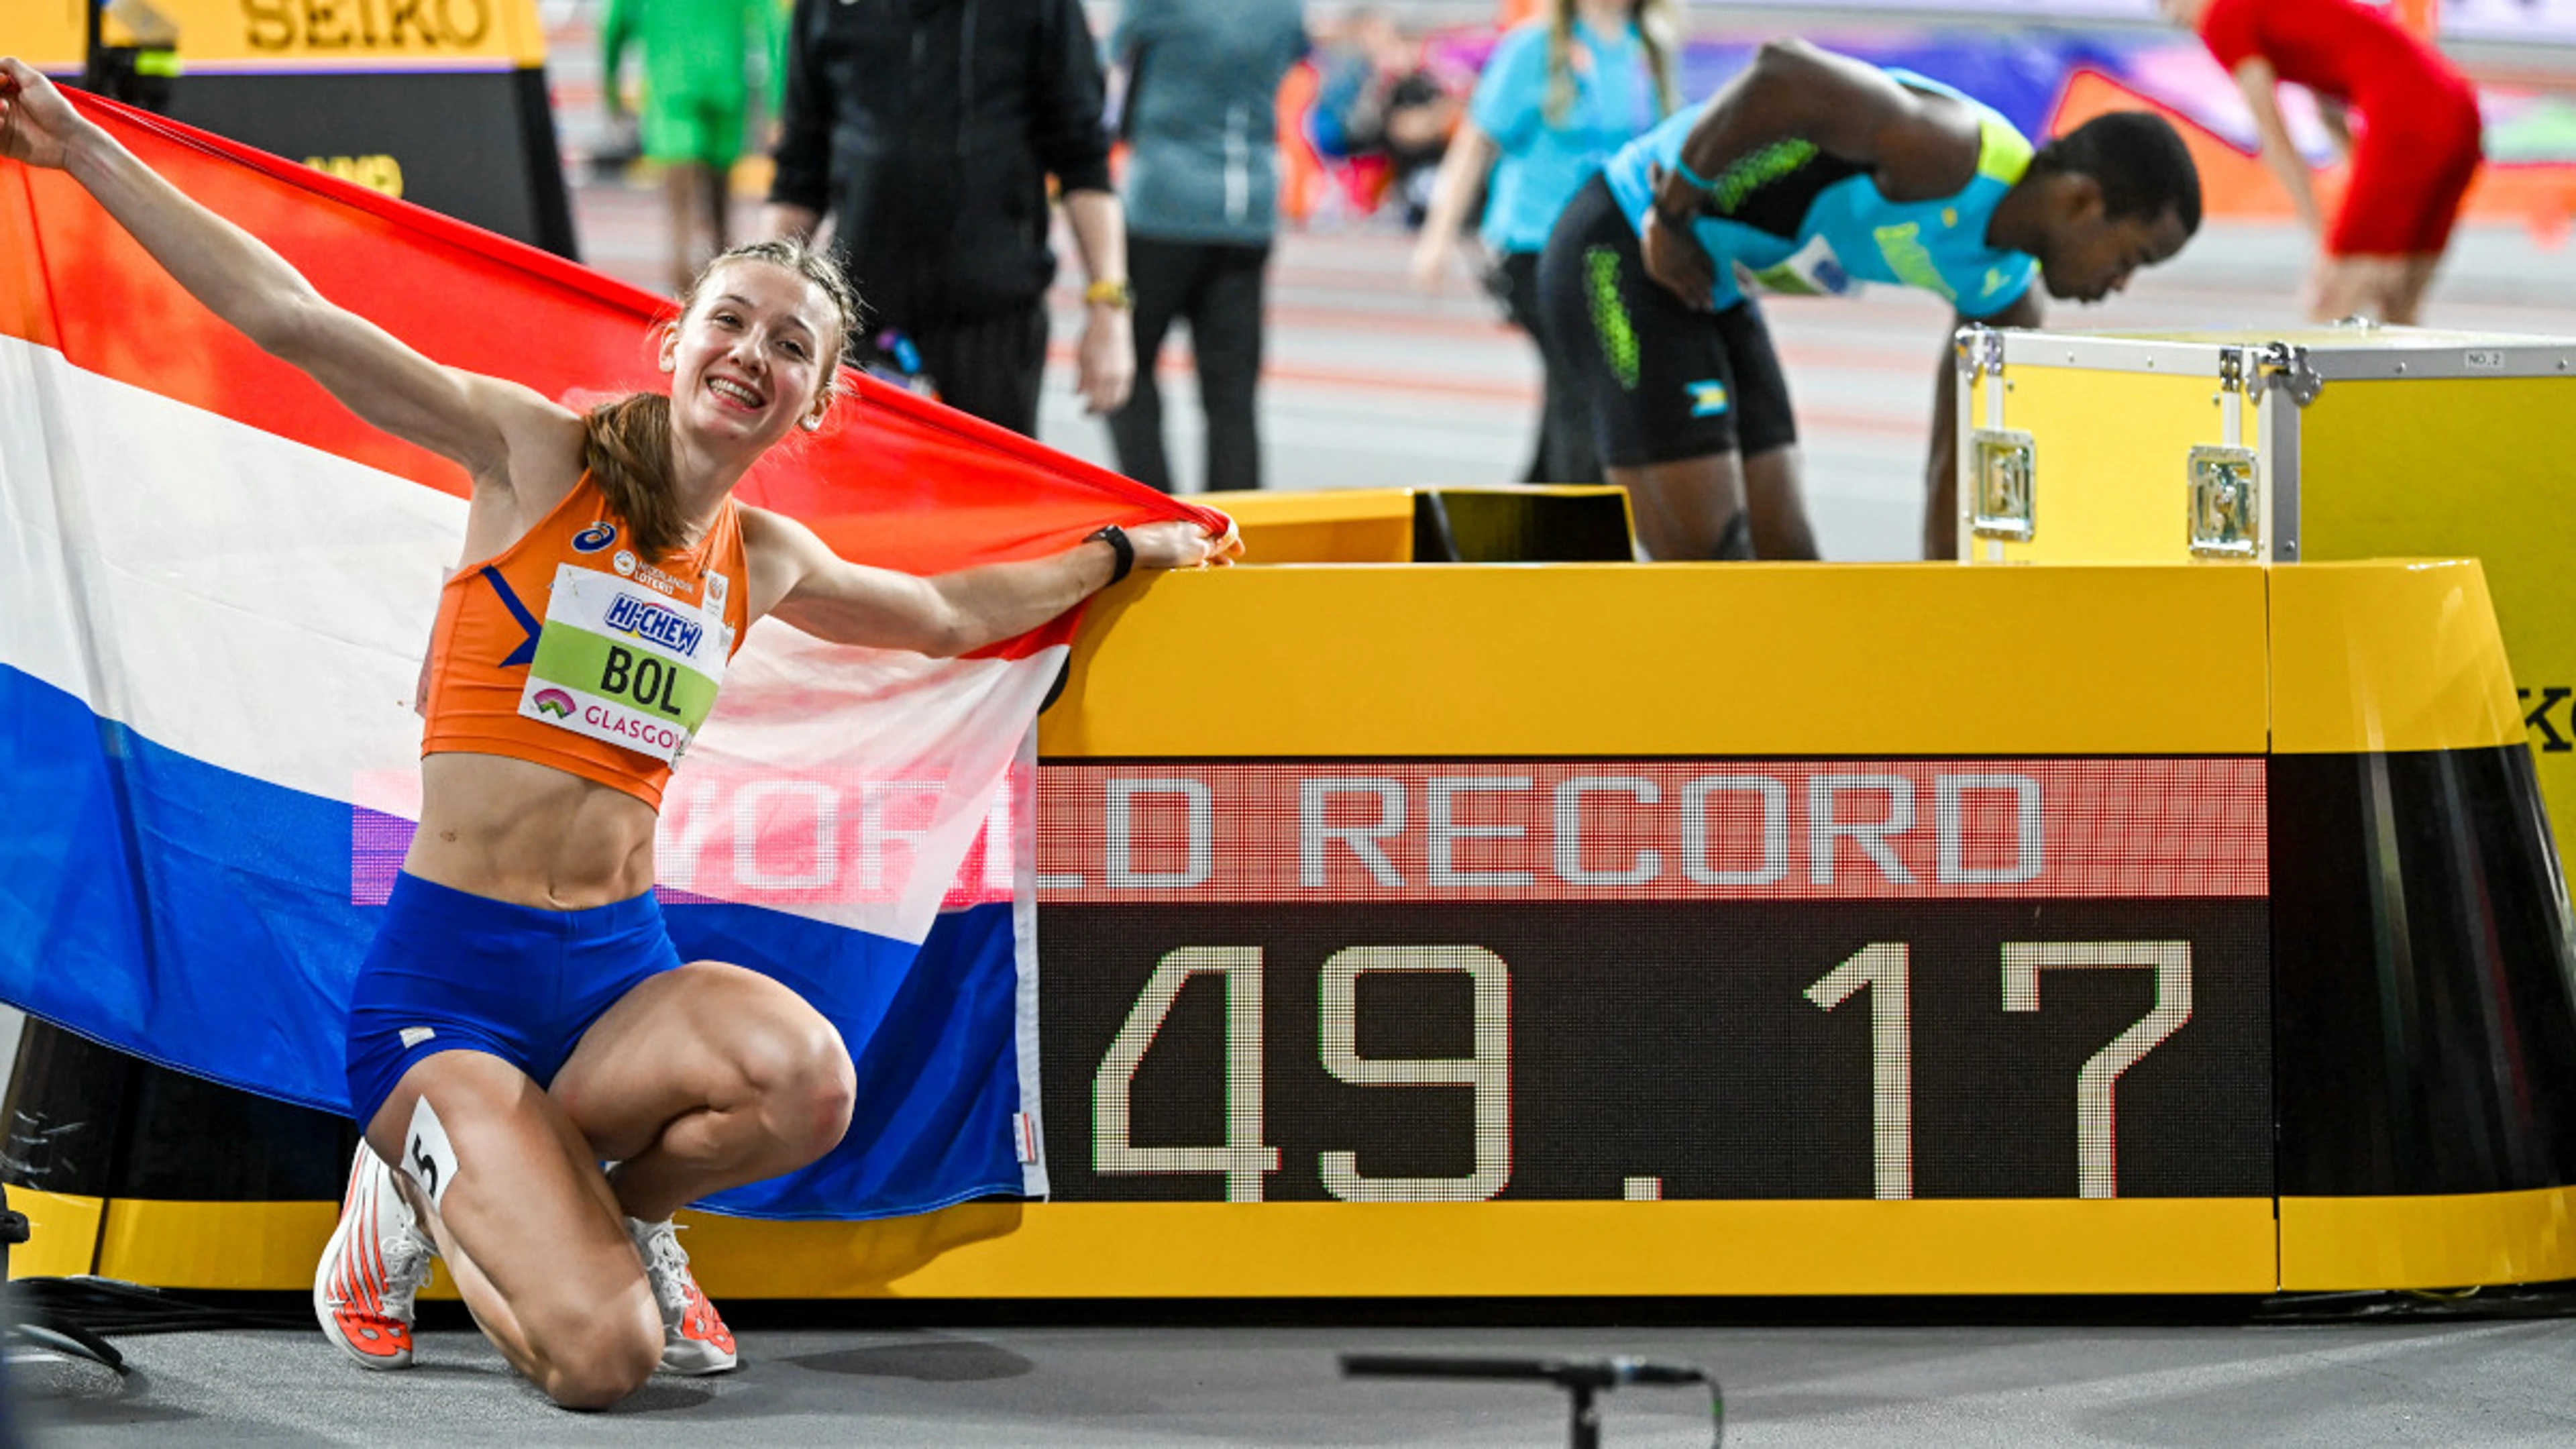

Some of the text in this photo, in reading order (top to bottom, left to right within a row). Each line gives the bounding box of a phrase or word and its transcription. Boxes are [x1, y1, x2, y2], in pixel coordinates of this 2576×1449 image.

[244, 0, 492, 51] SEIKO
[604, 593, 702, 657] HI-CHEW
[600, 645, 681, 716] BOL
[585, 706, 680, 749] GLASGO
[2517, 686, 2576, 752] K
[1299, 773, 2043, 888] RECORD
[412, 1133, 438, 1199] 5
